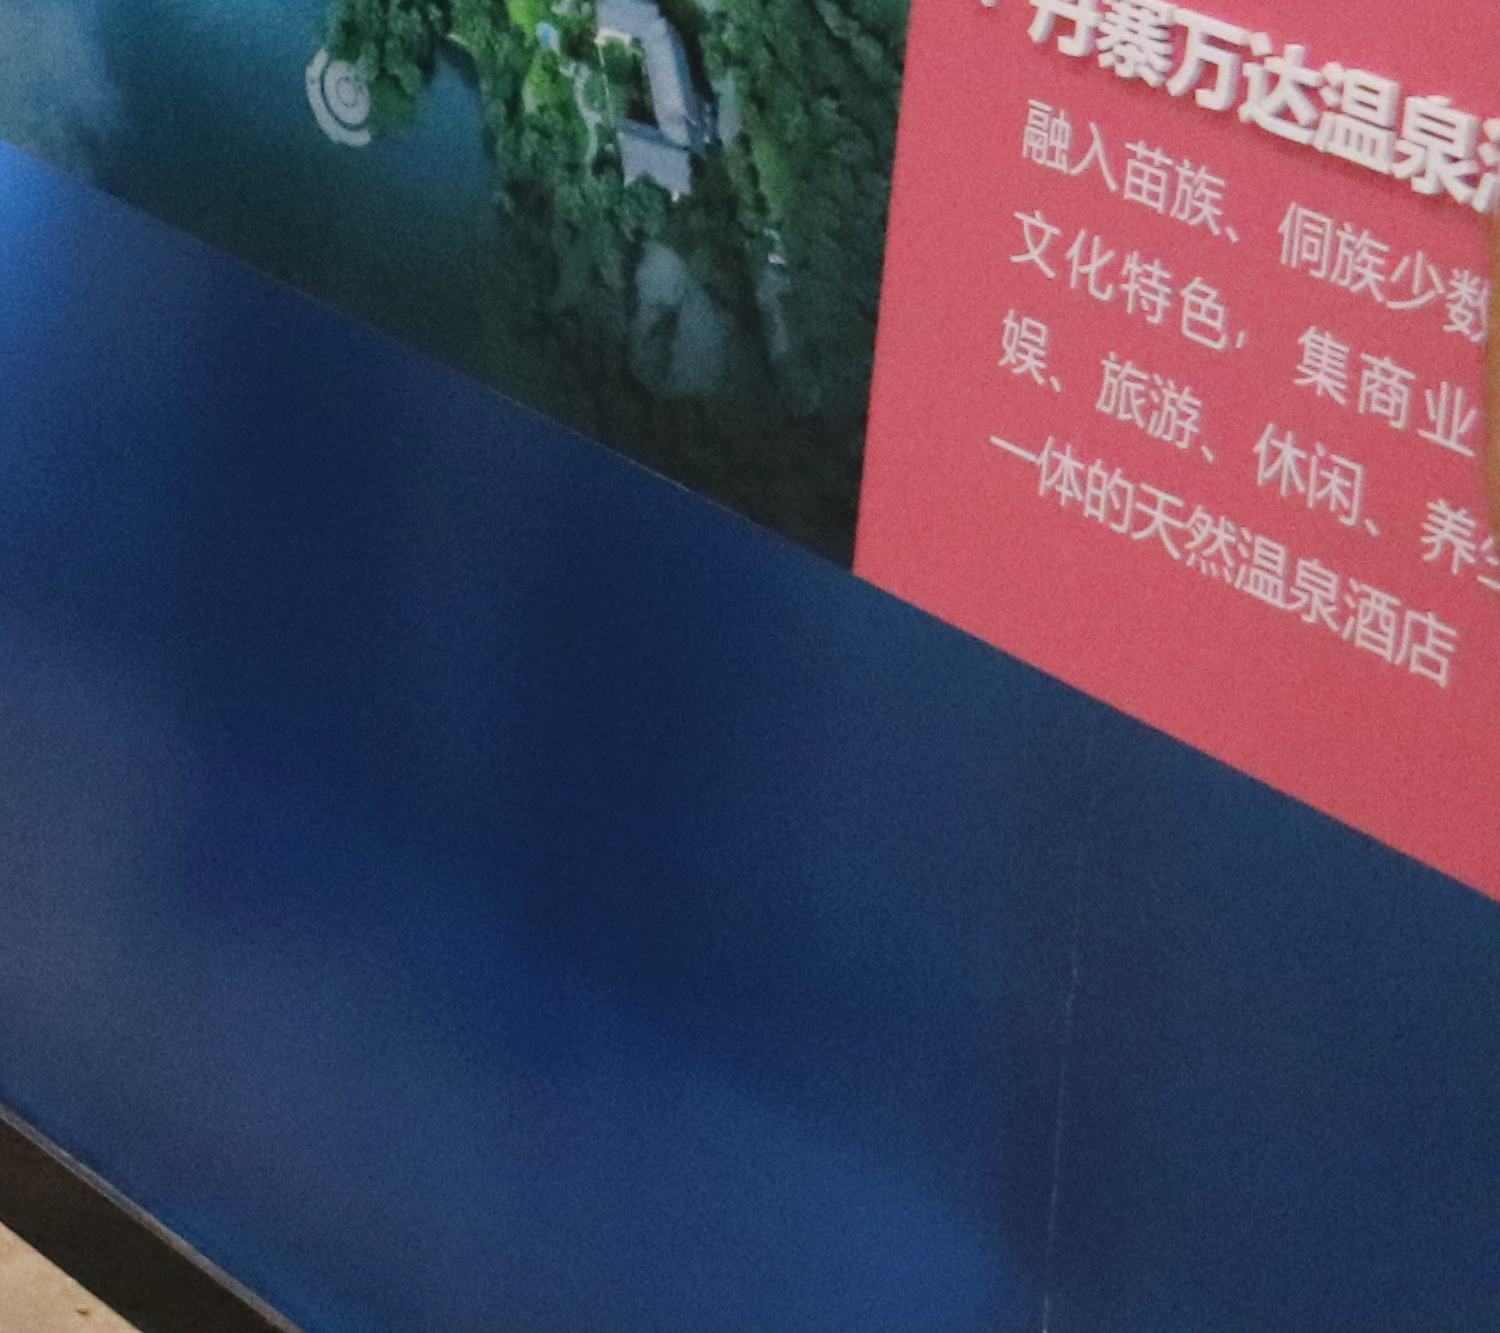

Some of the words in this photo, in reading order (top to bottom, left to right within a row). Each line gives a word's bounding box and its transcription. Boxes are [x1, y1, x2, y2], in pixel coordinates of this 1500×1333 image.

[1011, 209, 1478, 457] 文化特色，集商业
[1021, 98, 1491, 344] 融入苗族、侗族少数
[990, 436, 1460, 687] 一体的天然温泉酒店
